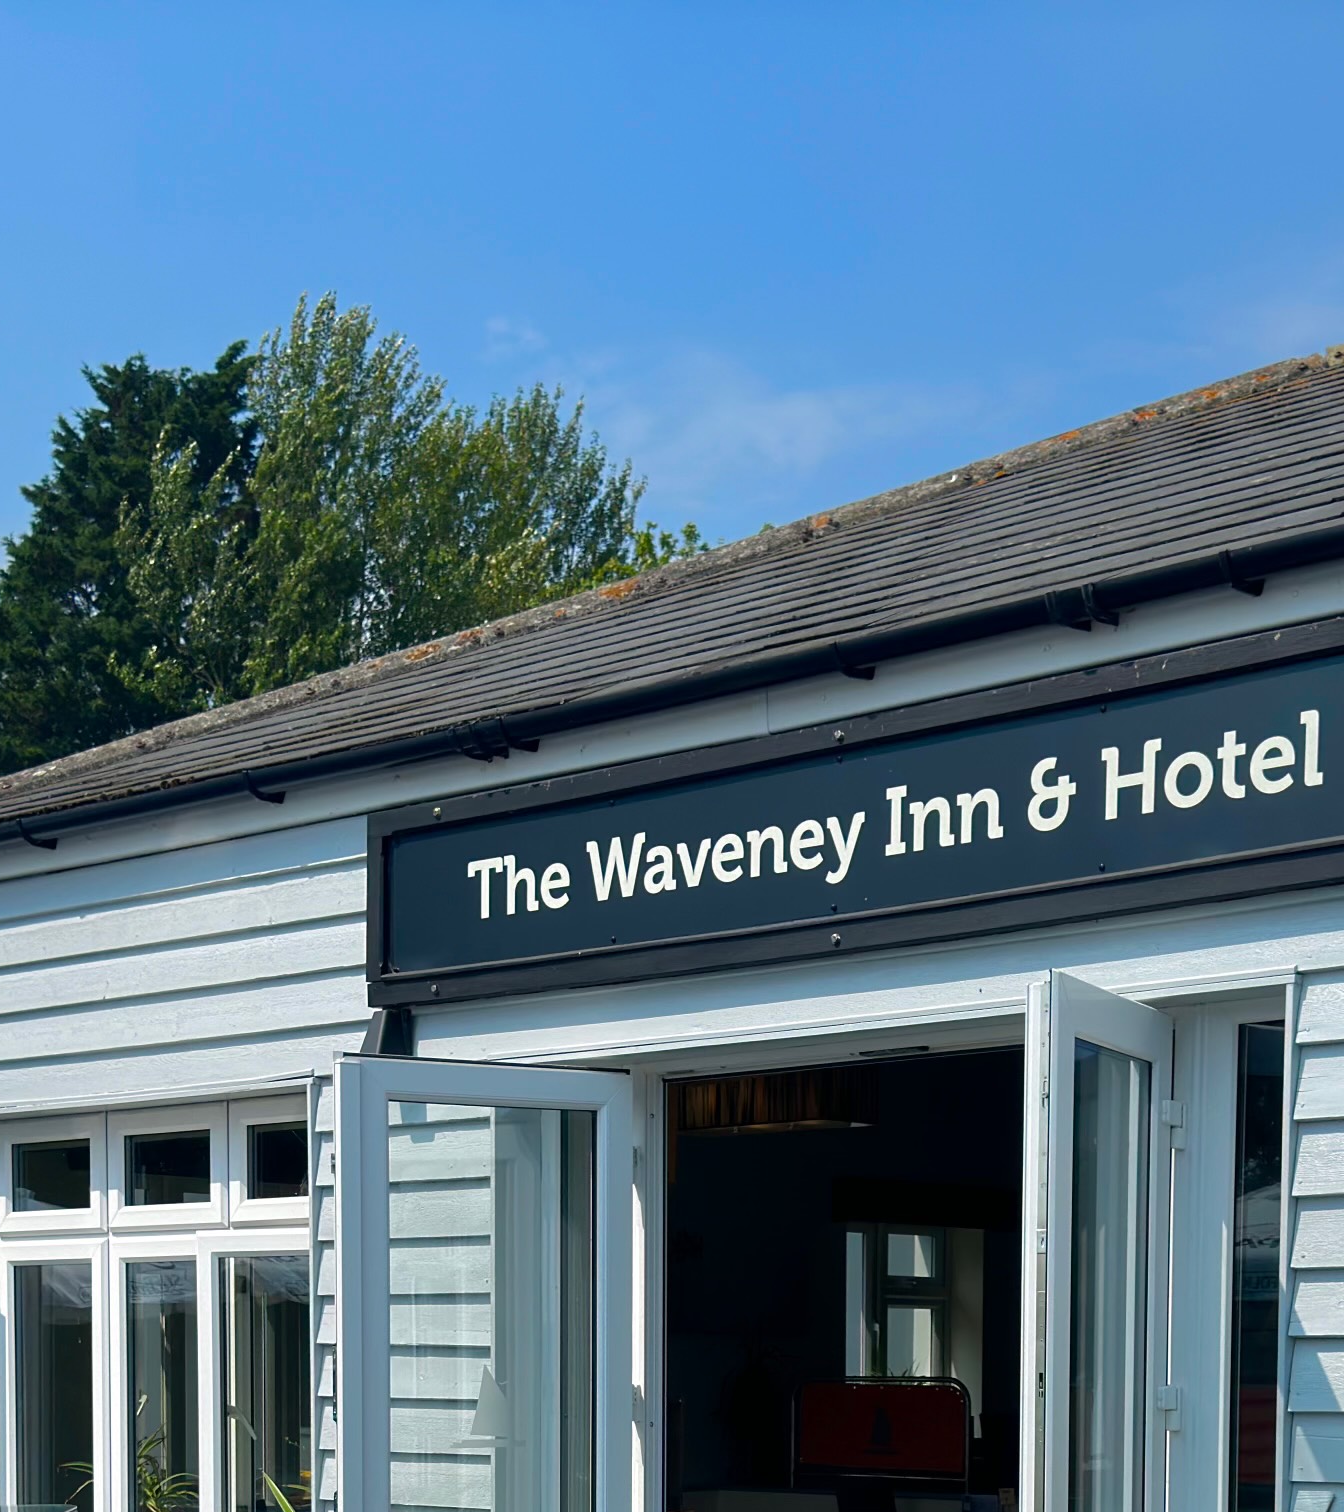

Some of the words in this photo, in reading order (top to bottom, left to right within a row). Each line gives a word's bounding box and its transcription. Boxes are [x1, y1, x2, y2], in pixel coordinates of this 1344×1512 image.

[467, 854, 570, 919] The
[586, 811, 866, 902] Waveney
[885, 784, 1004, 857] Inn
[1027, 756, 1077, 832] &
[1101, 709, 1324, 821] Hotel
